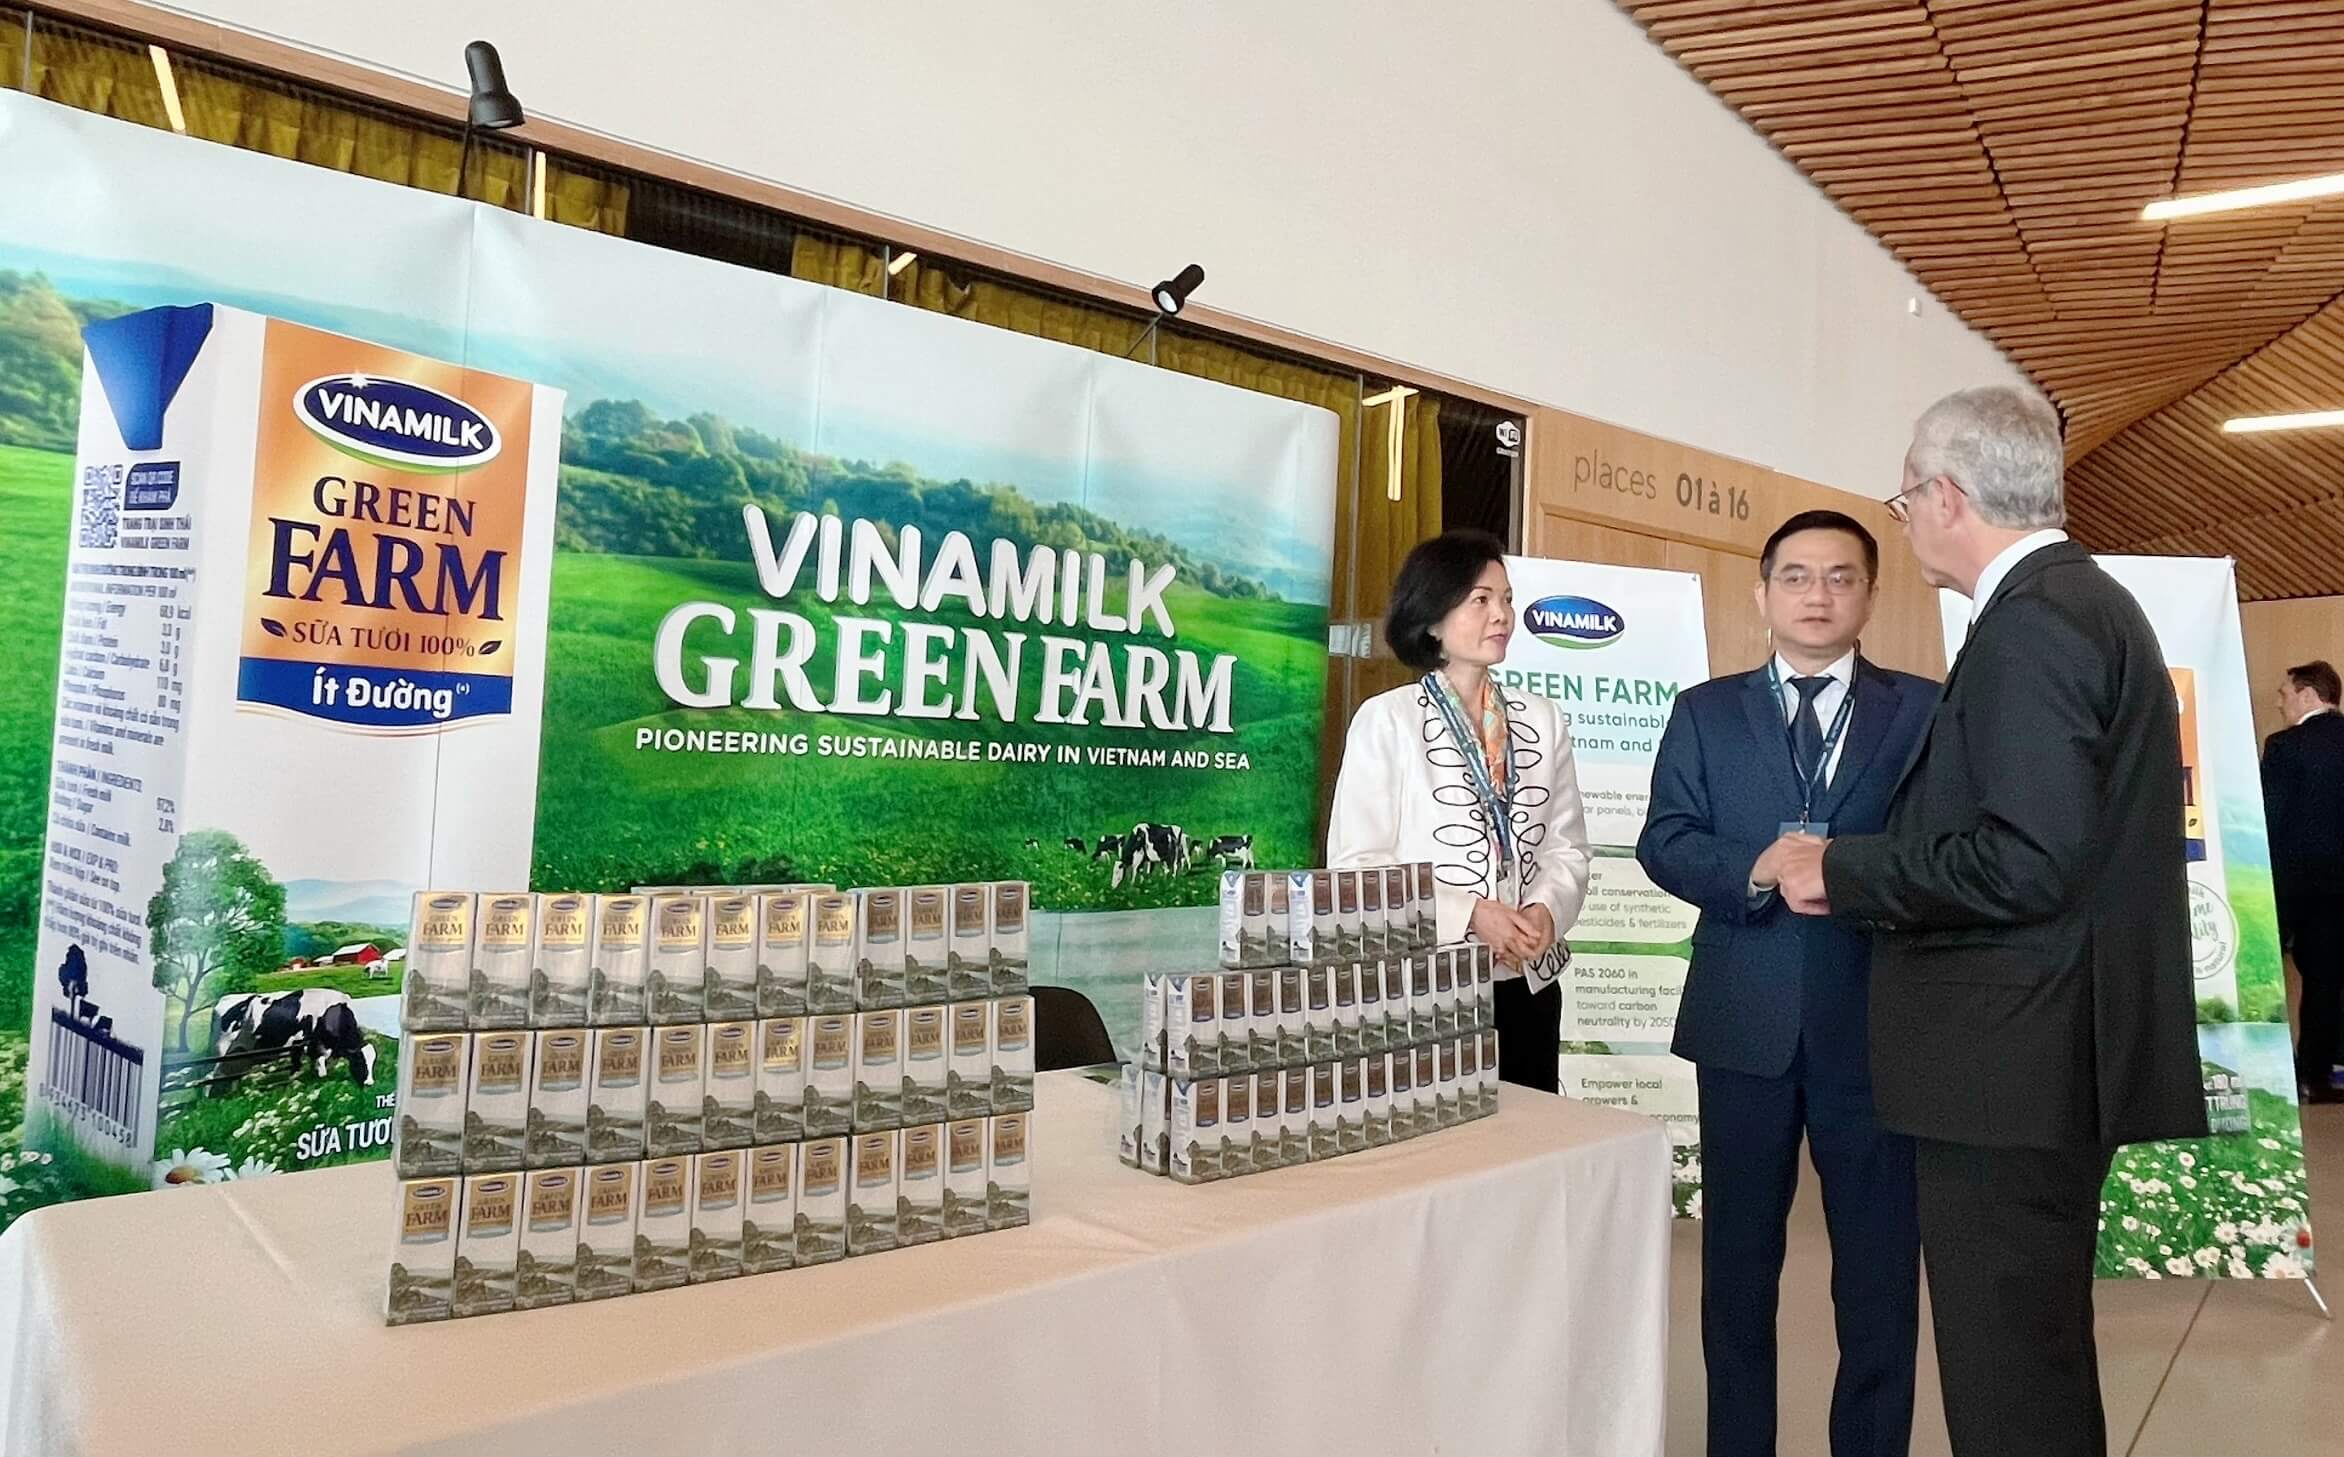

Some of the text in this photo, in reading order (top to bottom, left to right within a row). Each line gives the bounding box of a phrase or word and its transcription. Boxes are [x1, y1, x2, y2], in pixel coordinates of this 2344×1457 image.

[318, 388, 484, 450] VINAMILK
[1573, 448, 1750, 521] places 01 à 16
[313, 476, 477, 537] GREEN
[261, 517, 508, 621] FARM
[742, 503, 1177, 638] VINAMILK
[1531, 609, 1618, 632] VINAMILK
[292, 619, 475, 657] SỮA TƯƠI 100%
[653, 601, 1238, 732] GREEN FARM
[312, 666, 453, 718] Ít Đường
[1595, 676, 1680, 706] FARM
[1578, 713, 1670, 729] sustainabl
[636, 727, 1251, 770] PIONEERING SUSTAINABLE DAIRY IN VIETNAM AND SEA
[1571, 738, 1651, 752] tnam and
[1609, 902, 1621, 912] of
[1624, 903, 1672, 914] synthetic
[423, 922, 463, 936] FARM
[486, 922, 524, 936] FARM
[545, 922, 583, 936] FARM
[603, 922, 639, 936] FARM
[715, 923, 749, 936] FARM
[768, 920, 801, 934] FARM
[1578, 917, 1626, 928] esticides
[661, 925, 696, 938] FARM
[1574, 968, 1638, 979] PAS 2060 in
[1575, 985, 1682, 997] manufacturing facil
[1577, 1000, 1658, 1011] toward carbon
[1577, 1017, 1630, 1028] neutrality
[1633, 1017, 1647, 1029] by
[661, 1053, 696, 1067] FARM
[714, 1050, 749, 1064] FARM
[415, 1064, 457, 1079] FARM
[481, 1062, 520, 1077] FARM
[543, 1060, 580, 1074] FARM
[1581, 1078, 1663, 1090] Empower local
[1630, 1095, 1639, 1105] &
[296, 1116, 394, 1161] SỮA TƯƠ
[647, 1185, 682, 1200] FARM
[702, 1179, 737, 1193] FARM
[591, 1192, 627, 1208] FARM
[470, 1204, 511, 1220] FARM
[532, 1201, 570, 1216] FARM
[406, 1210, 448, 1226] FARM
